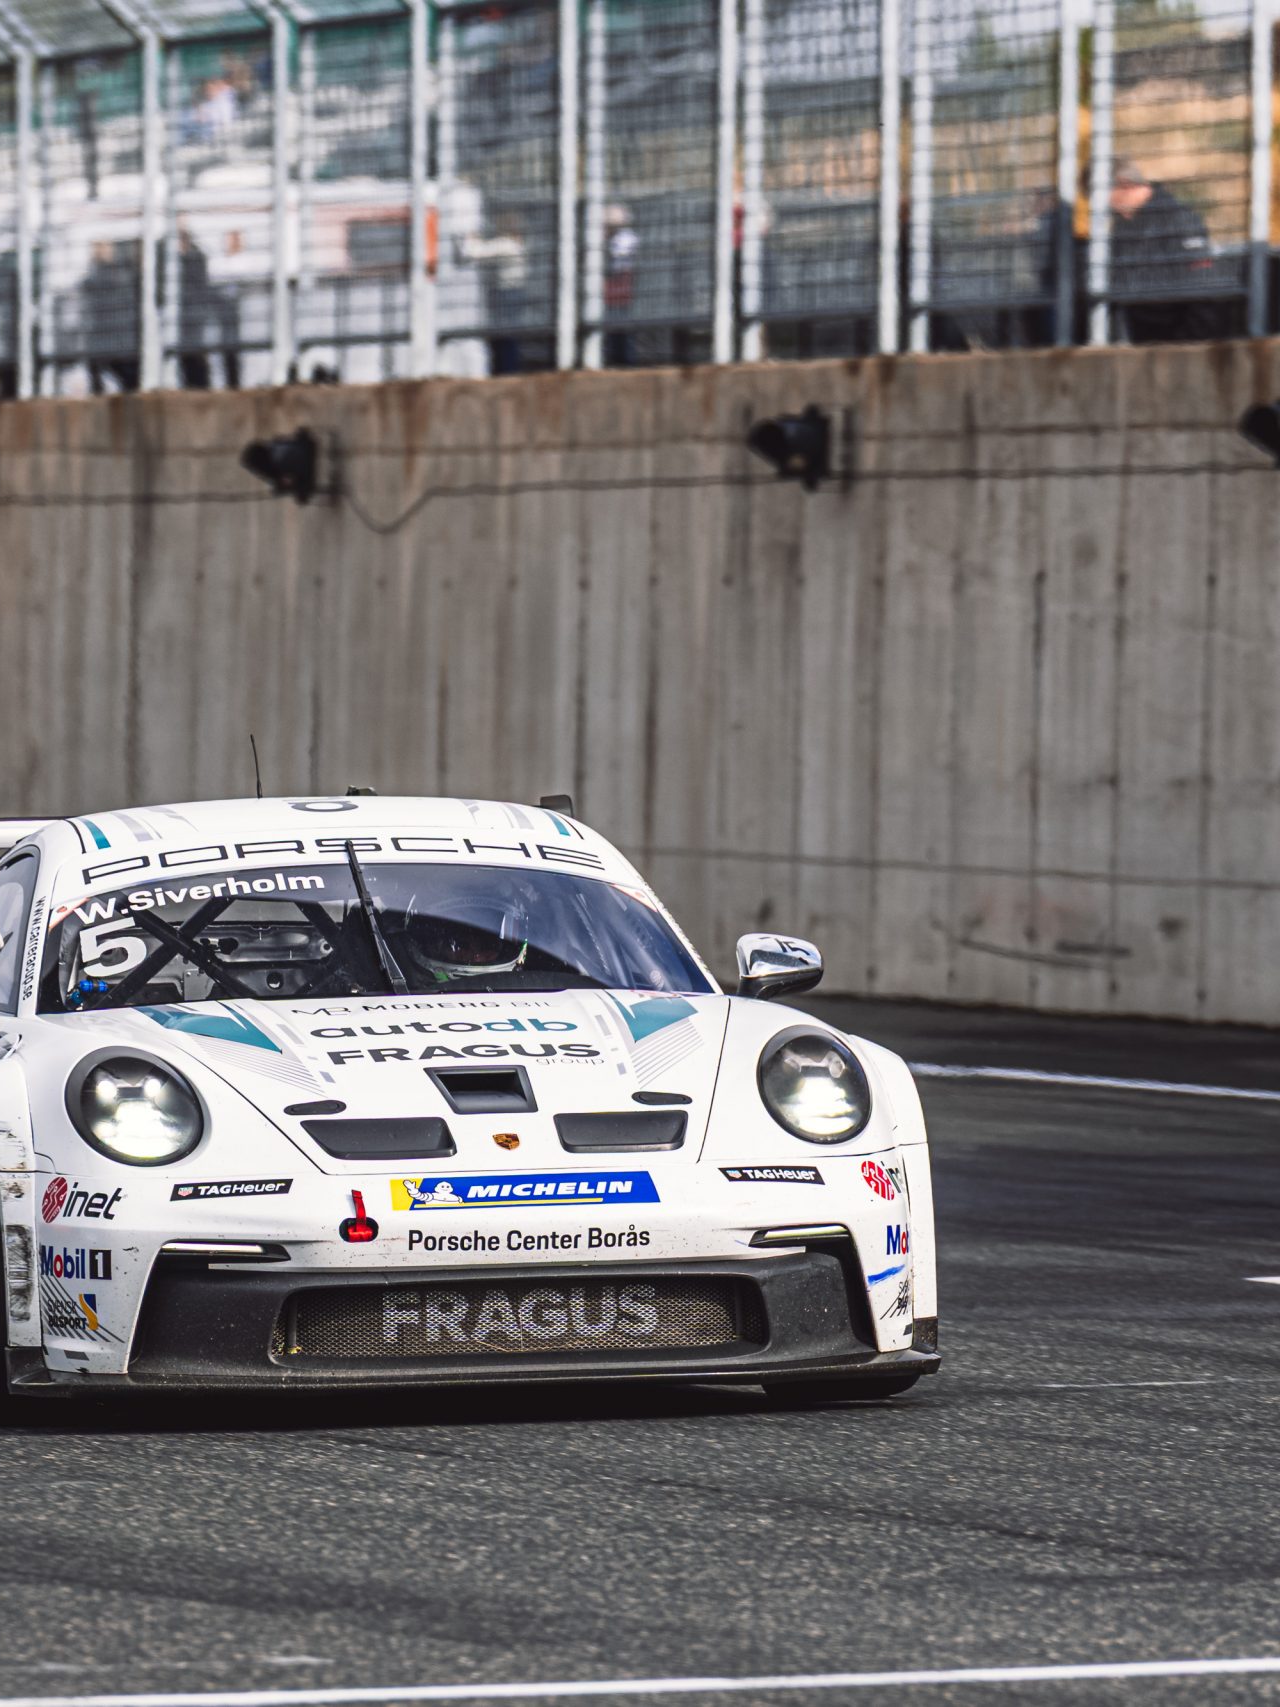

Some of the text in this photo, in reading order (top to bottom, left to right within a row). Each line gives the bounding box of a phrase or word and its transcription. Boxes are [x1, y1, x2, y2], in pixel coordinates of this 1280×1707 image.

[81, 836, 606, 885] PORSCHE
[75, 873, 325, 925] W.Siverholm
[22, 896, 47, 1001] www.carreracup.se
[79, 917, 147, 978] 5
[361, 1001, 501, 1013] MOBERG
[309, 1018, 578, 1039] autodb
[326, 1043, 602, 1066] FRAGUS
[534, 1056, 606, 1066] group
[62, 1181, 123, 1221] inet
[467, 1180, 633, 1199] MICHELIN
[408, 1224, 650, 1251] Porsche Center Borås
[41, 1244, 86, 1280] Mobil
[382, 1284, 658, 1343] FRAGUS
